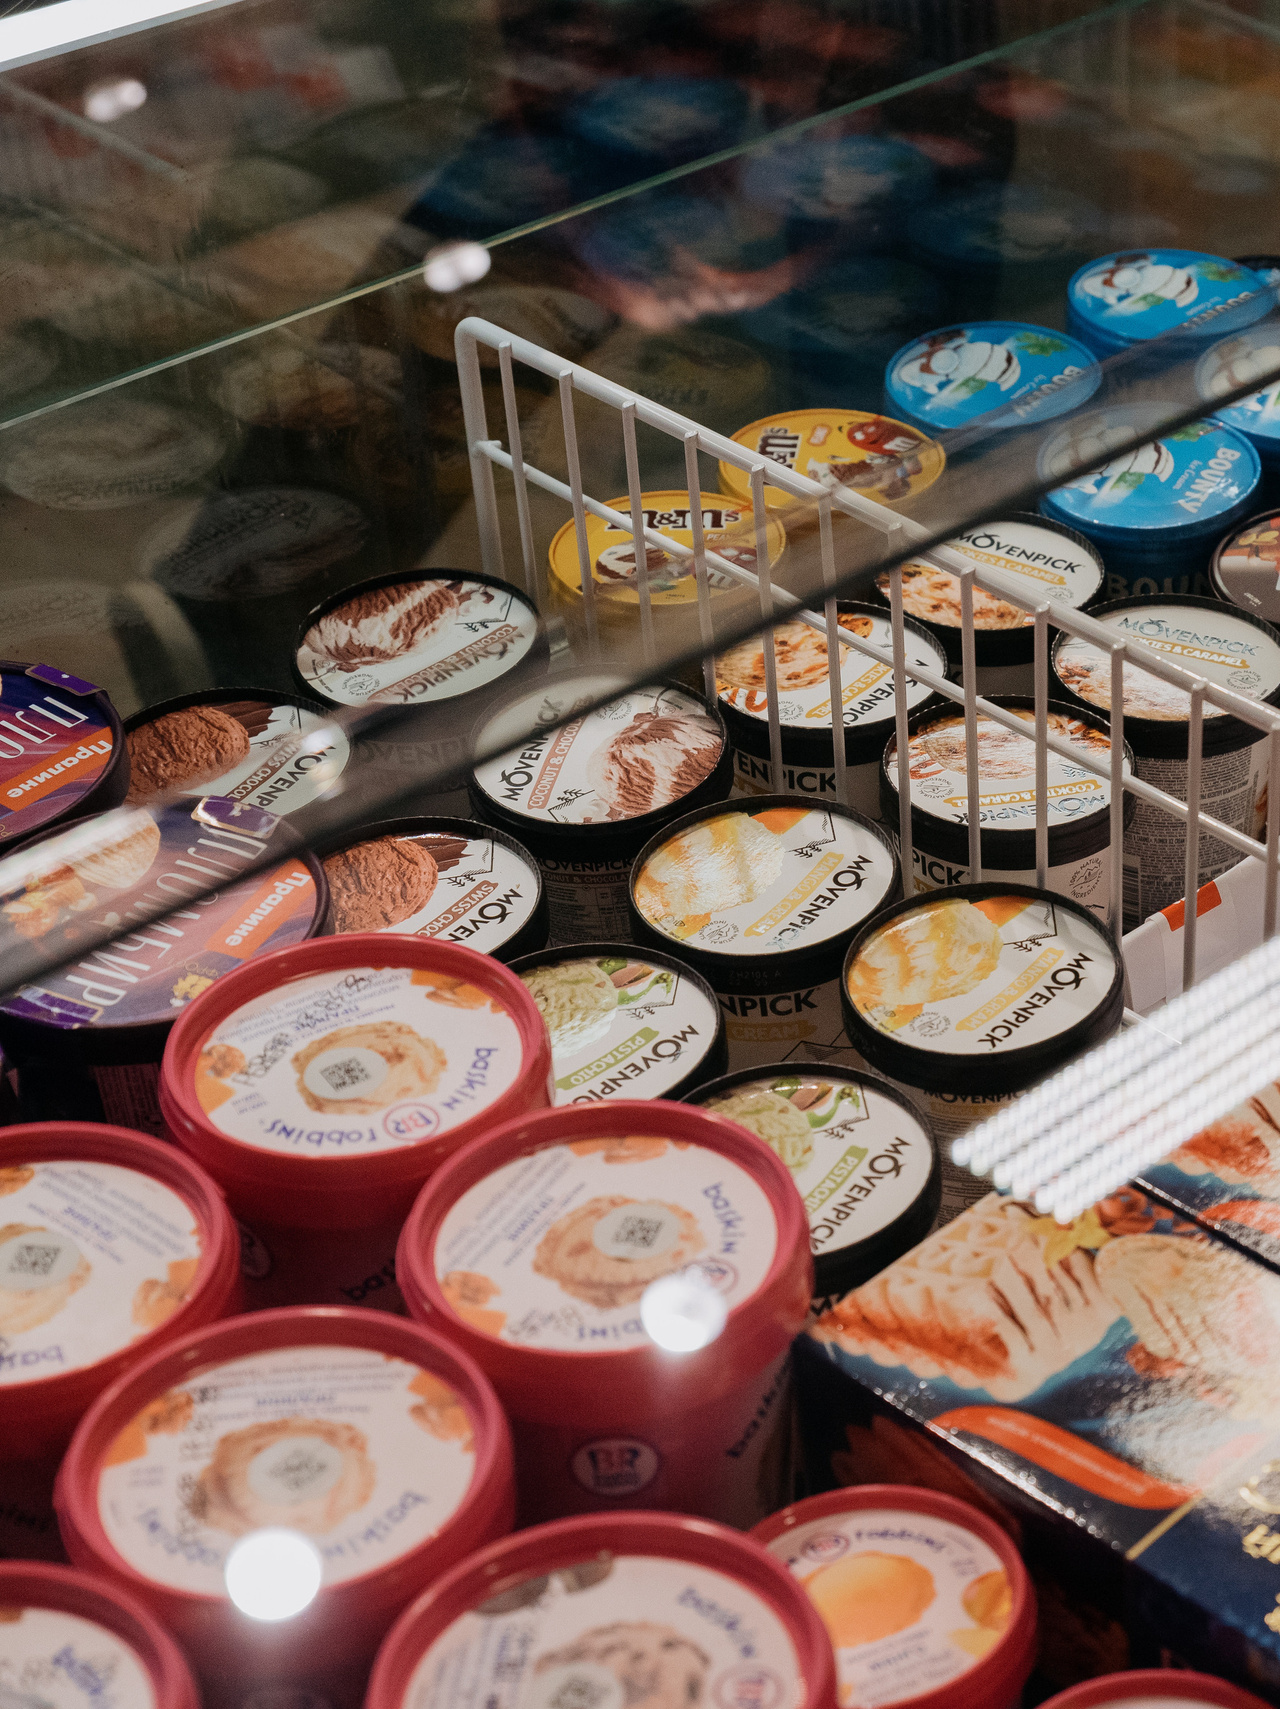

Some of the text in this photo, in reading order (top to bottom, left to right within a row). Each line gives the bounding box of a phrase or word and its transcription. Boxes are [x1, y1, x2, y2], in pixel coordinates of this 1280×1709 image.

[1178, 448, 1241, 514] BOUNTY
[1006, 561, 1065, 584] CARAMEL
[1183, 648, 1243, 667] CARAMEL
[6, 739, 113, 799] Пралине
[227, 767, 270, 801] CHOCOL
[529, 763, 560, 808] COCONUT
[737, 756, 838, 793] ENPICK
[225, 871, 311, 946] Пралине
[452, 882, 495, 917] SWISS
[718, 988, 820, 1018] NPICK
[442, 1047, 499, 1110] baskin
[571, 1035, 646, 1086] PISTACHIO
[264, 1118, 377, 1146] robbins
